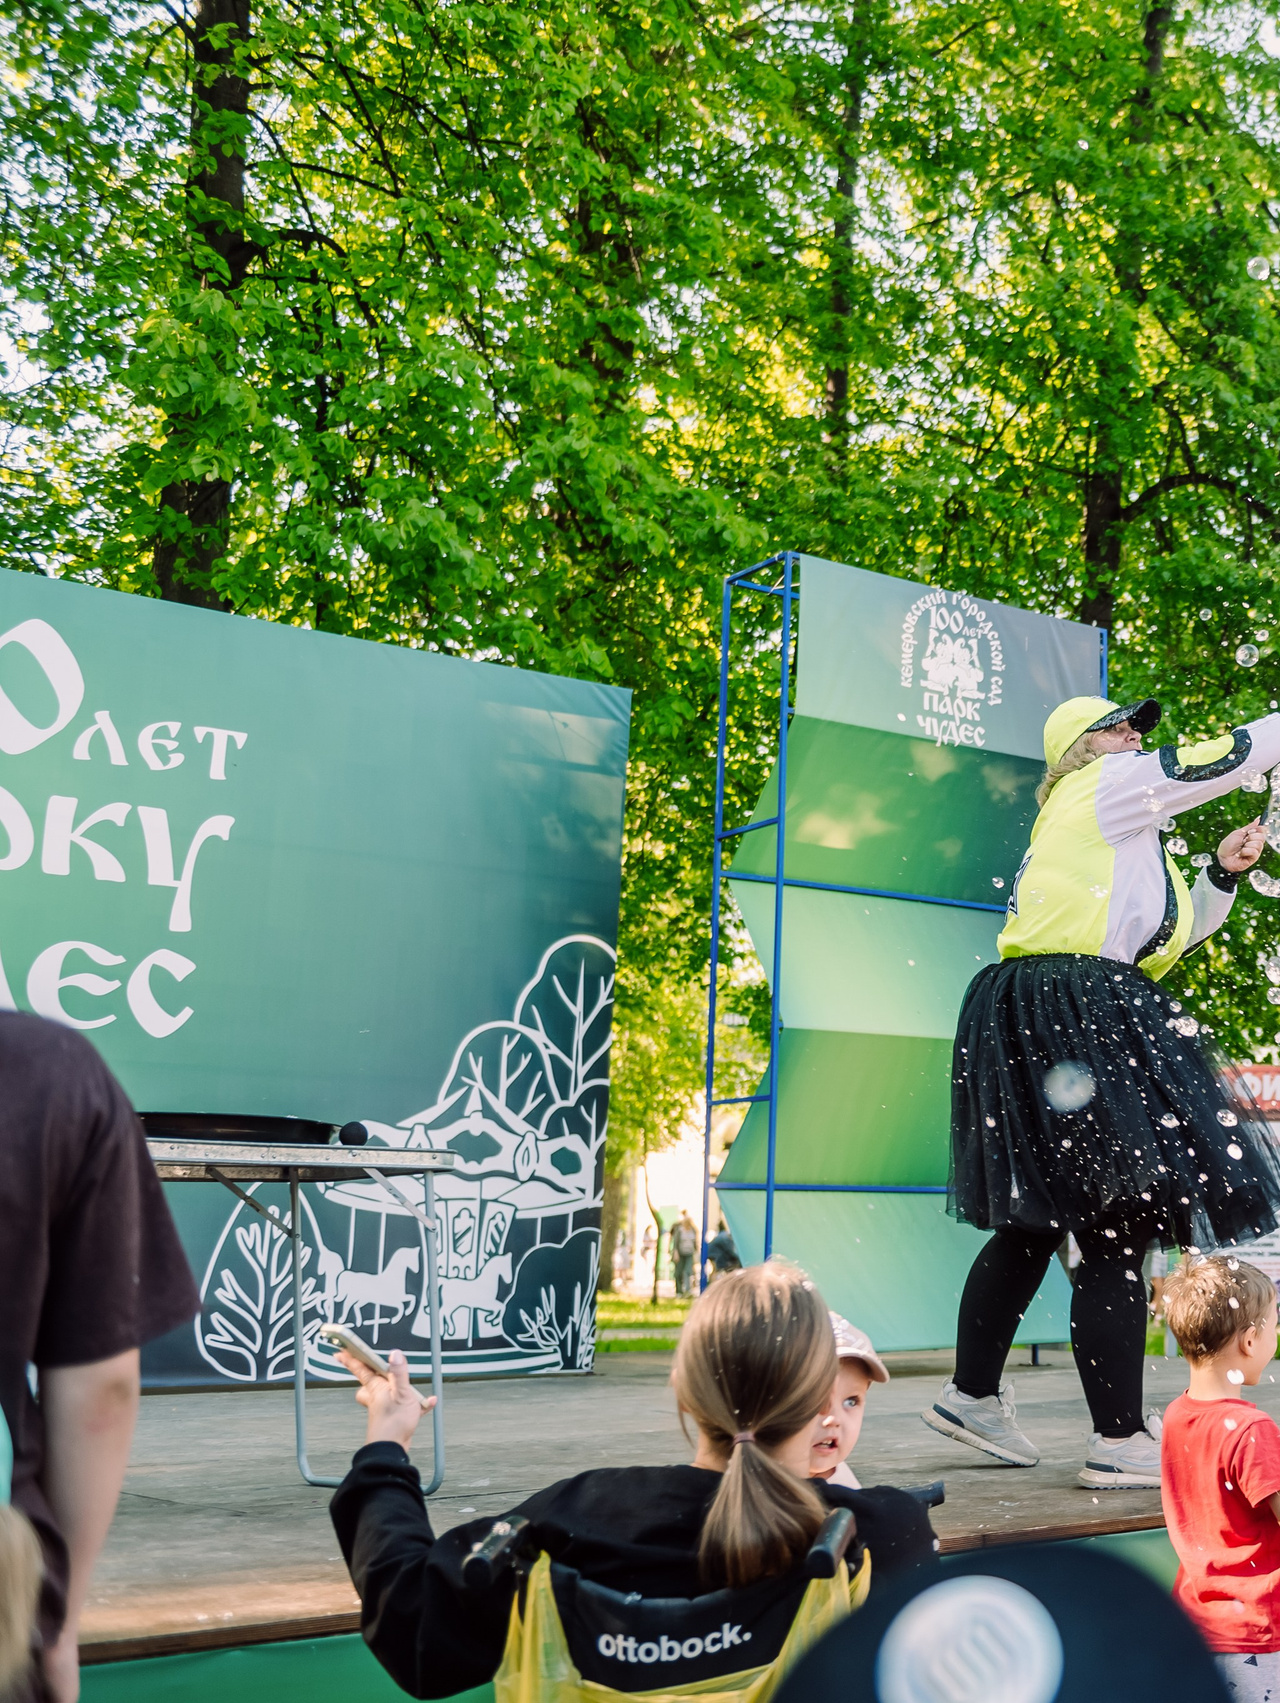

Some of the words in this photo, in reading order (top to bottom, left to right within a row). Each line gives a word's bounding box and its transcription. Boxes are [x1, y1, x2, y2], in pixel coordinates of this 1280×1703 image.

[928, 605, 964, 634] 100
[923, 692, 981, 726] ПАРК
[73, 710, 248, 780] ЛЕТ
[916, 715, 986, 747] ЧУДЕС
[0, 937, 196, 1038] ЕС
[598, 1622, 752, 1663] ottobock.
